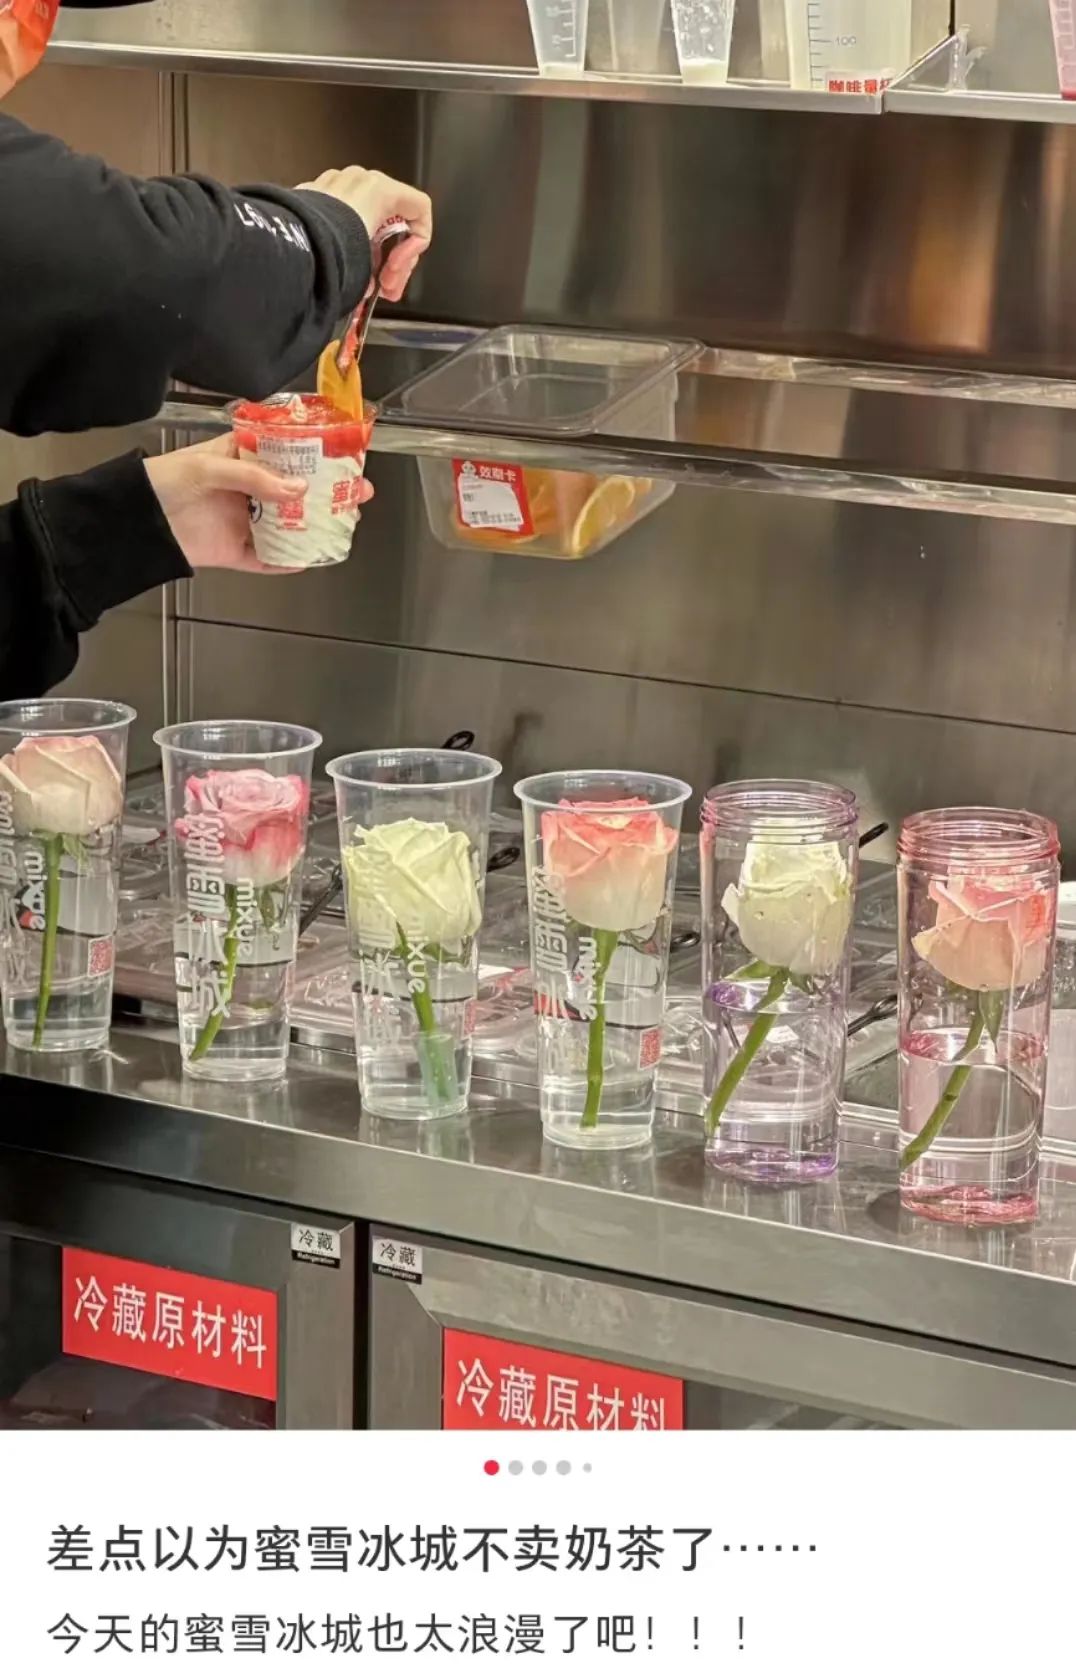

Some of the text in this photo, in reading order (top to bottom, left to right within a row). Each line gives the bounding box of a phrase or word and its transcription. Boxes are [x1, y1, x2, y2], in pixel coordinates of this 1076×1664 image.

[835, 35, 857, 47] 100
[236, 878, 257, 957] mixue
[299, 1228, 334, 1252] 冷藏
[380, 1242, 416, 1267] 冷藏
[73, 1275, 267, 1370] 冷藏原材料
[455, 1358, 664, 1430] 冷藏原材料
